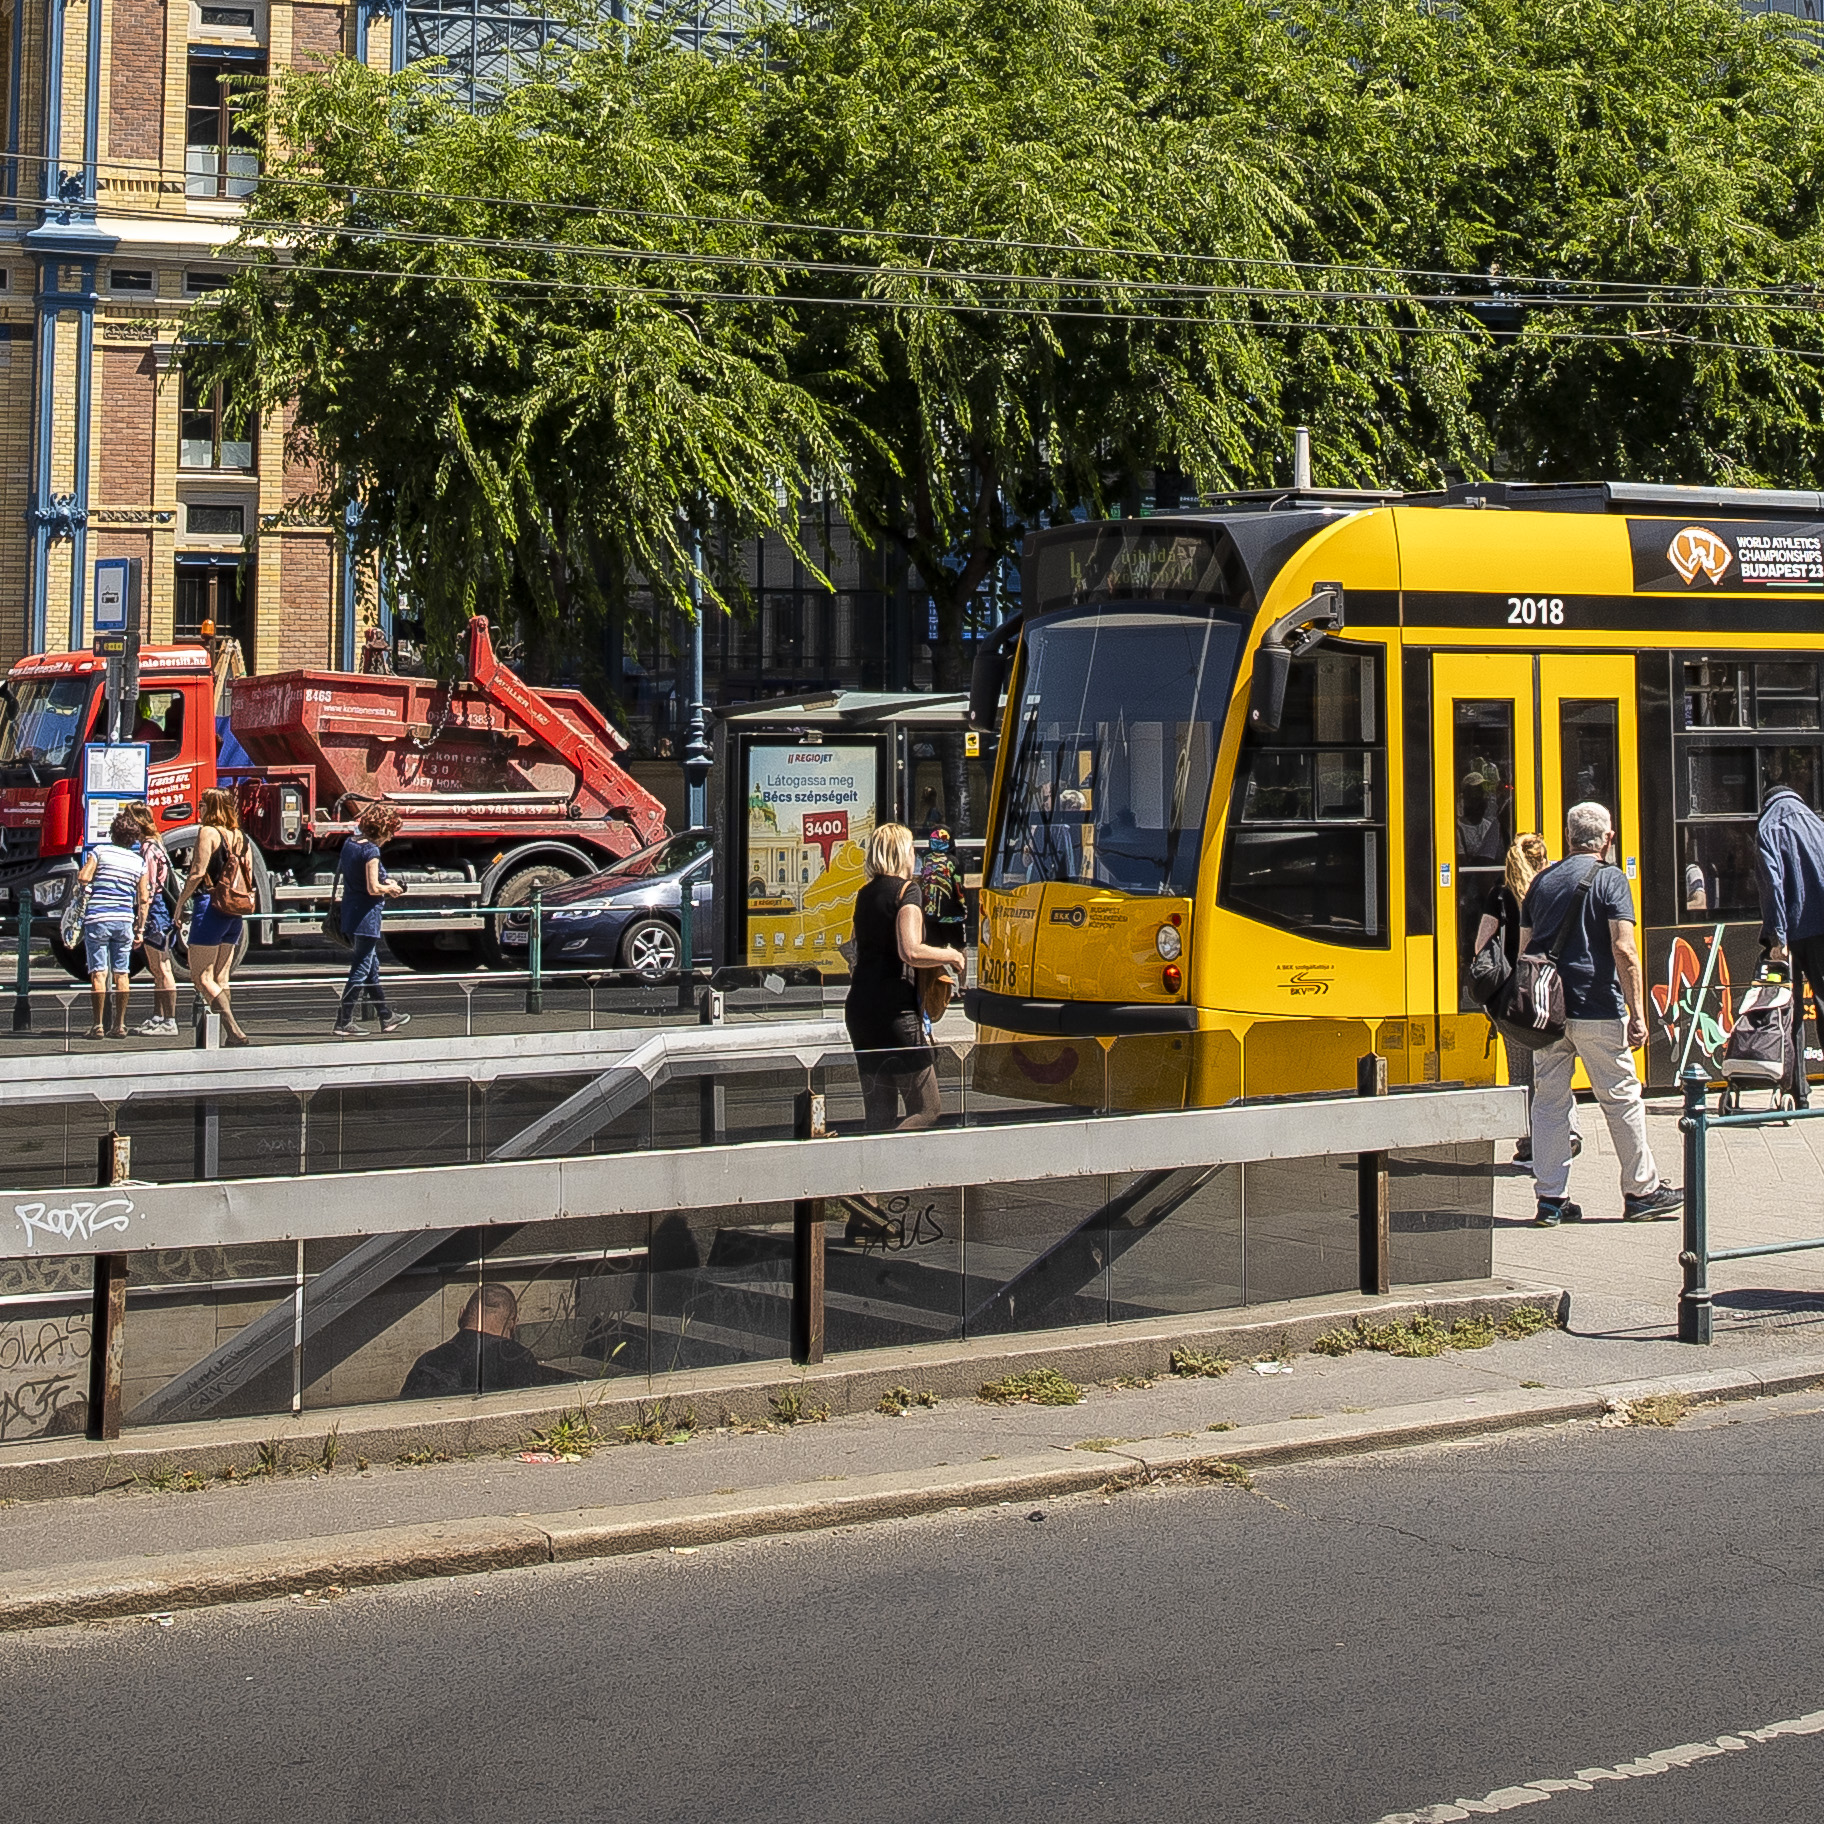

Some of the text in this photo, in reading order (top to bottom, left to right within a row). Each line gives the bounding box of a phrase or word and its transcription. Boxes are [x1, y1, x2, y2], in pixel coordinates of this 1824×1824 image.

[1736, 536, 1821, 550] WORLD ATHLETICS
[1738, 549, 1822, 563] CHAMPIONSHIPS
[1740, 563, 1824, 578] BUDAPEST 23
[1507, 597, 1565, 625] 2018
[794, 753, 833, 764] REGIOJET
[767, 774, 854, 788] Látogassa meg
[762, 789, 858, 805] Bécs szépségeit
[453, 805, 543, 816] 06 30 944 38 39
[805, 819, 842, 837] 3400
[1002, 906, 1035, 919] BUDAPEST
[1053, 912, 1070, 920] BKK
[990, 958, 1017, 987] 2018
